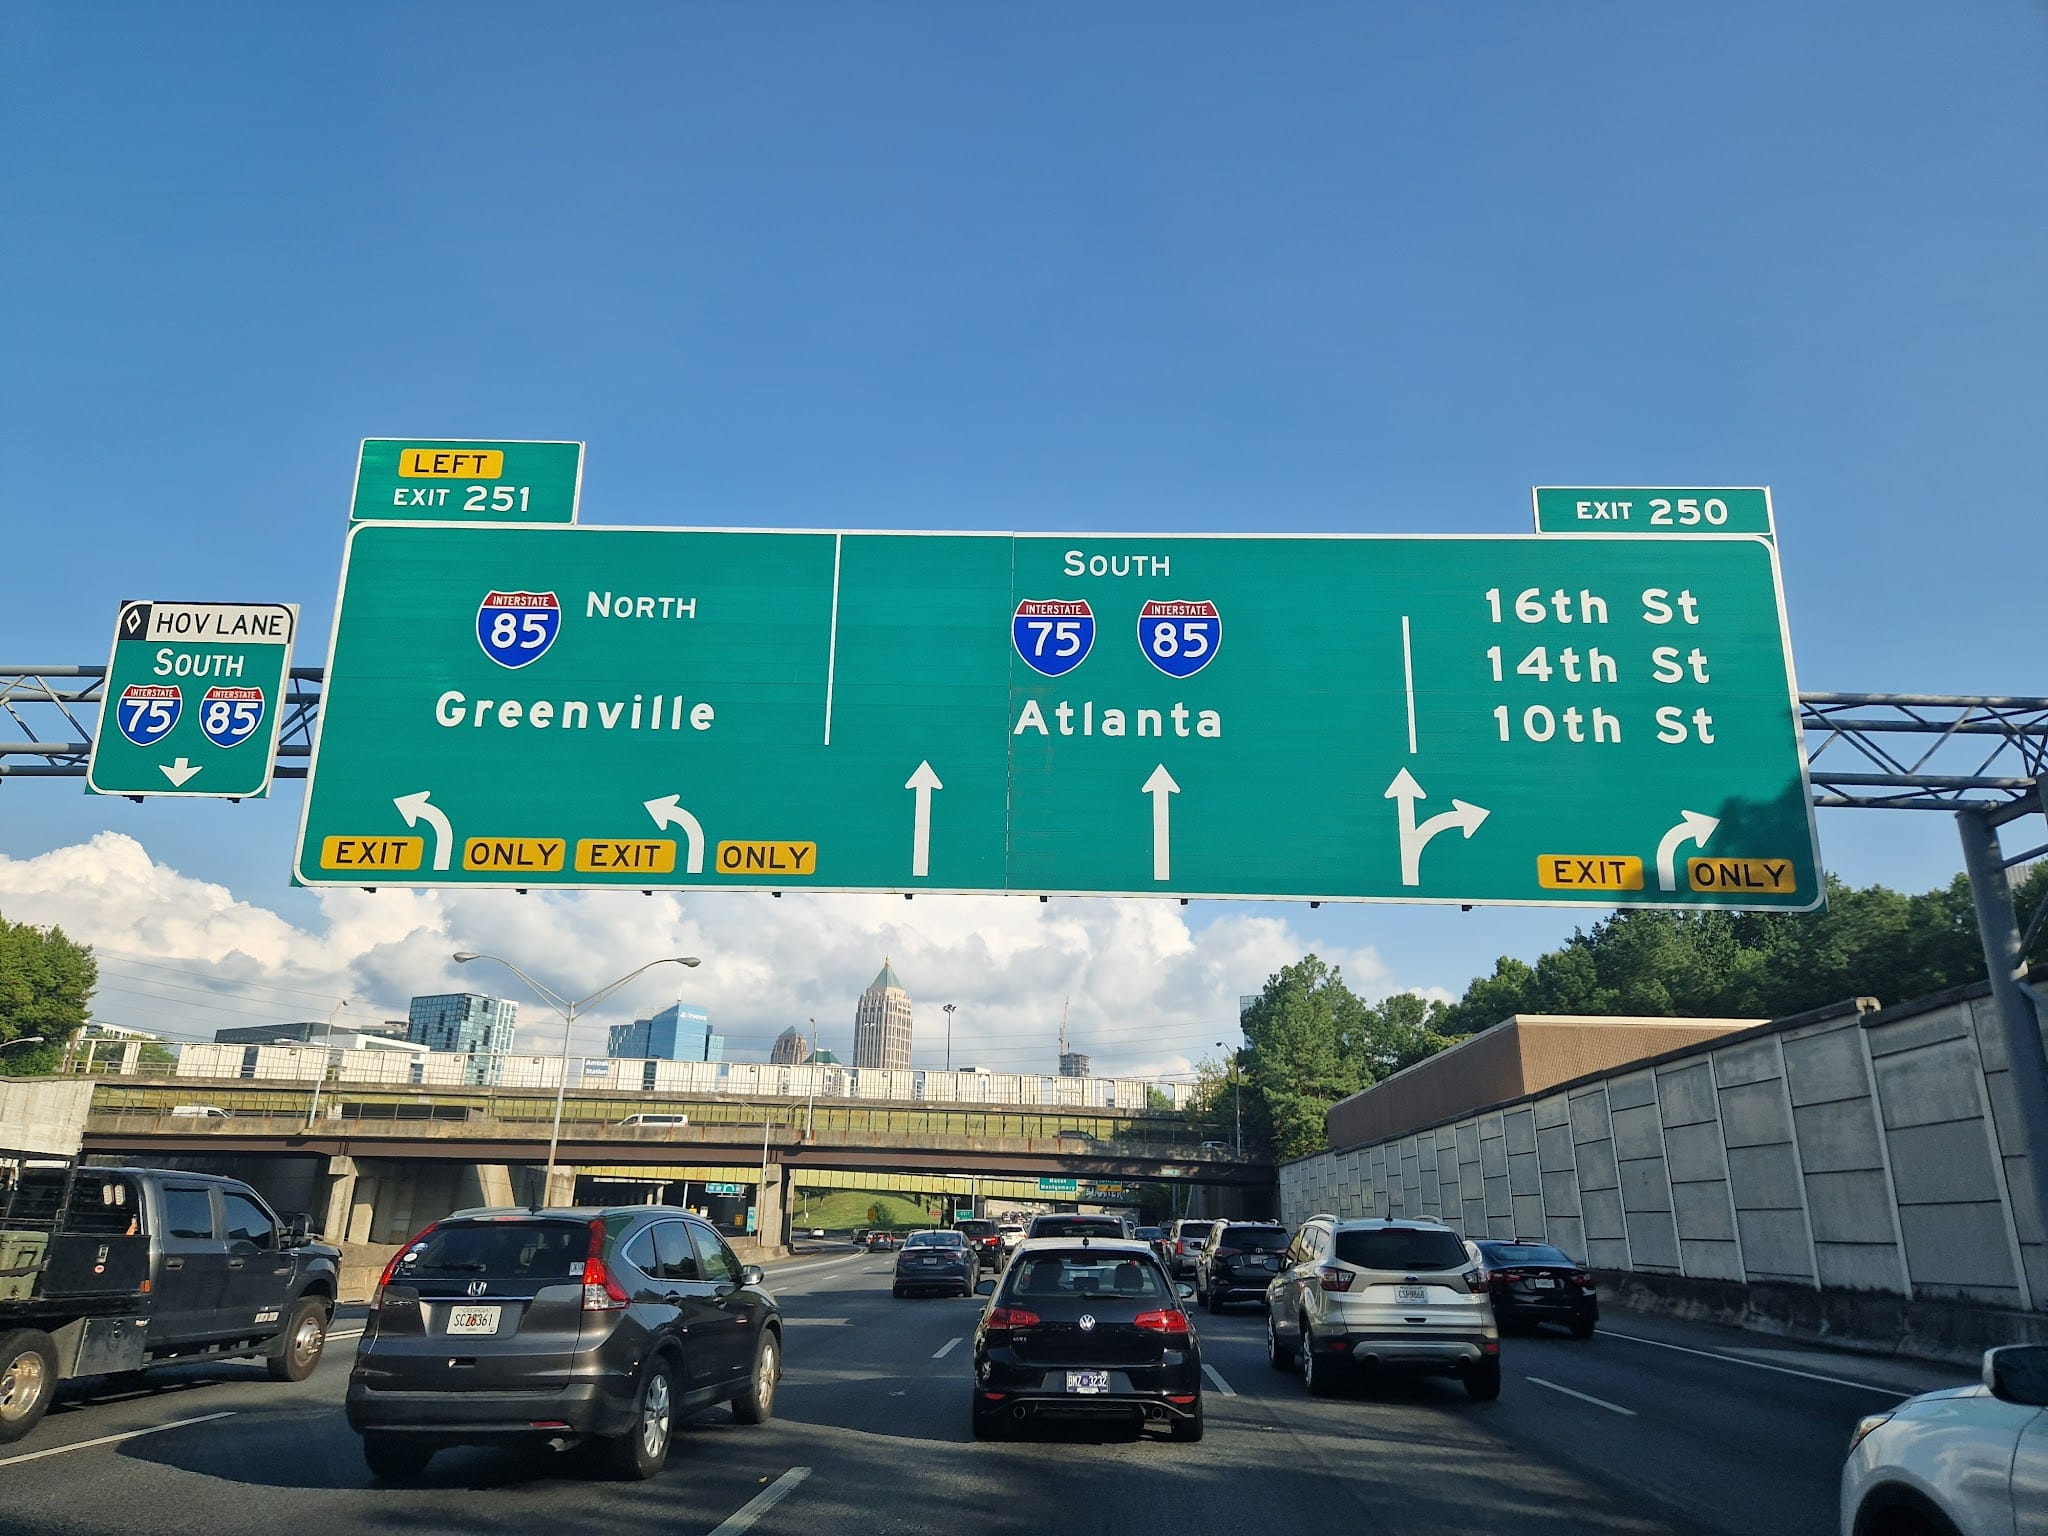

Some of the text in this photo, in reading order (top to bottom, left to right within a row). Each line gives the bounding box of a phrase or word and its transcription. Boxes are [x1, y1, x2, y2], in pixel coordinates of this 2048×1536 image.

[413, 453, 488, 474] LEFT
[393, 486, 531, 512] EXIT 251
[1576, 498, 1728, 526] EXIT 250
[492, 594, 550, 607] INTERSTATE
[1025, 604, 1082, 616] INTERSTATE
[1151, 604, 1208, 616] INTERSTATE
[1485, 587, 1699, 625] 16th St
[156, 612, 284, 636] HOV LANE
[490, 613, 548, 650] 85
[1027, 621, 1081, 658] 75
[1153, 623, 1209, 659] 85
[1486, 646, 1710, 684] 14th St
[130, 688, 174, 698] INTERSTATE
[212, 690, 257, 700] INTERSTATE
[125, 699, 174, 734] 75
[206, 701, 259, 735] 85
[435, 690, 716, 731] Greenville
[1014, 699, 1222, 738] Atlanta
[1494, 705, 1716, 744] 10th St
[335, 841, 560, 867] EXIT ONLY
[589, 844, 810, 869] EXIT ONLY
[1554, 860, 1786, 888] EXIT ONLY
